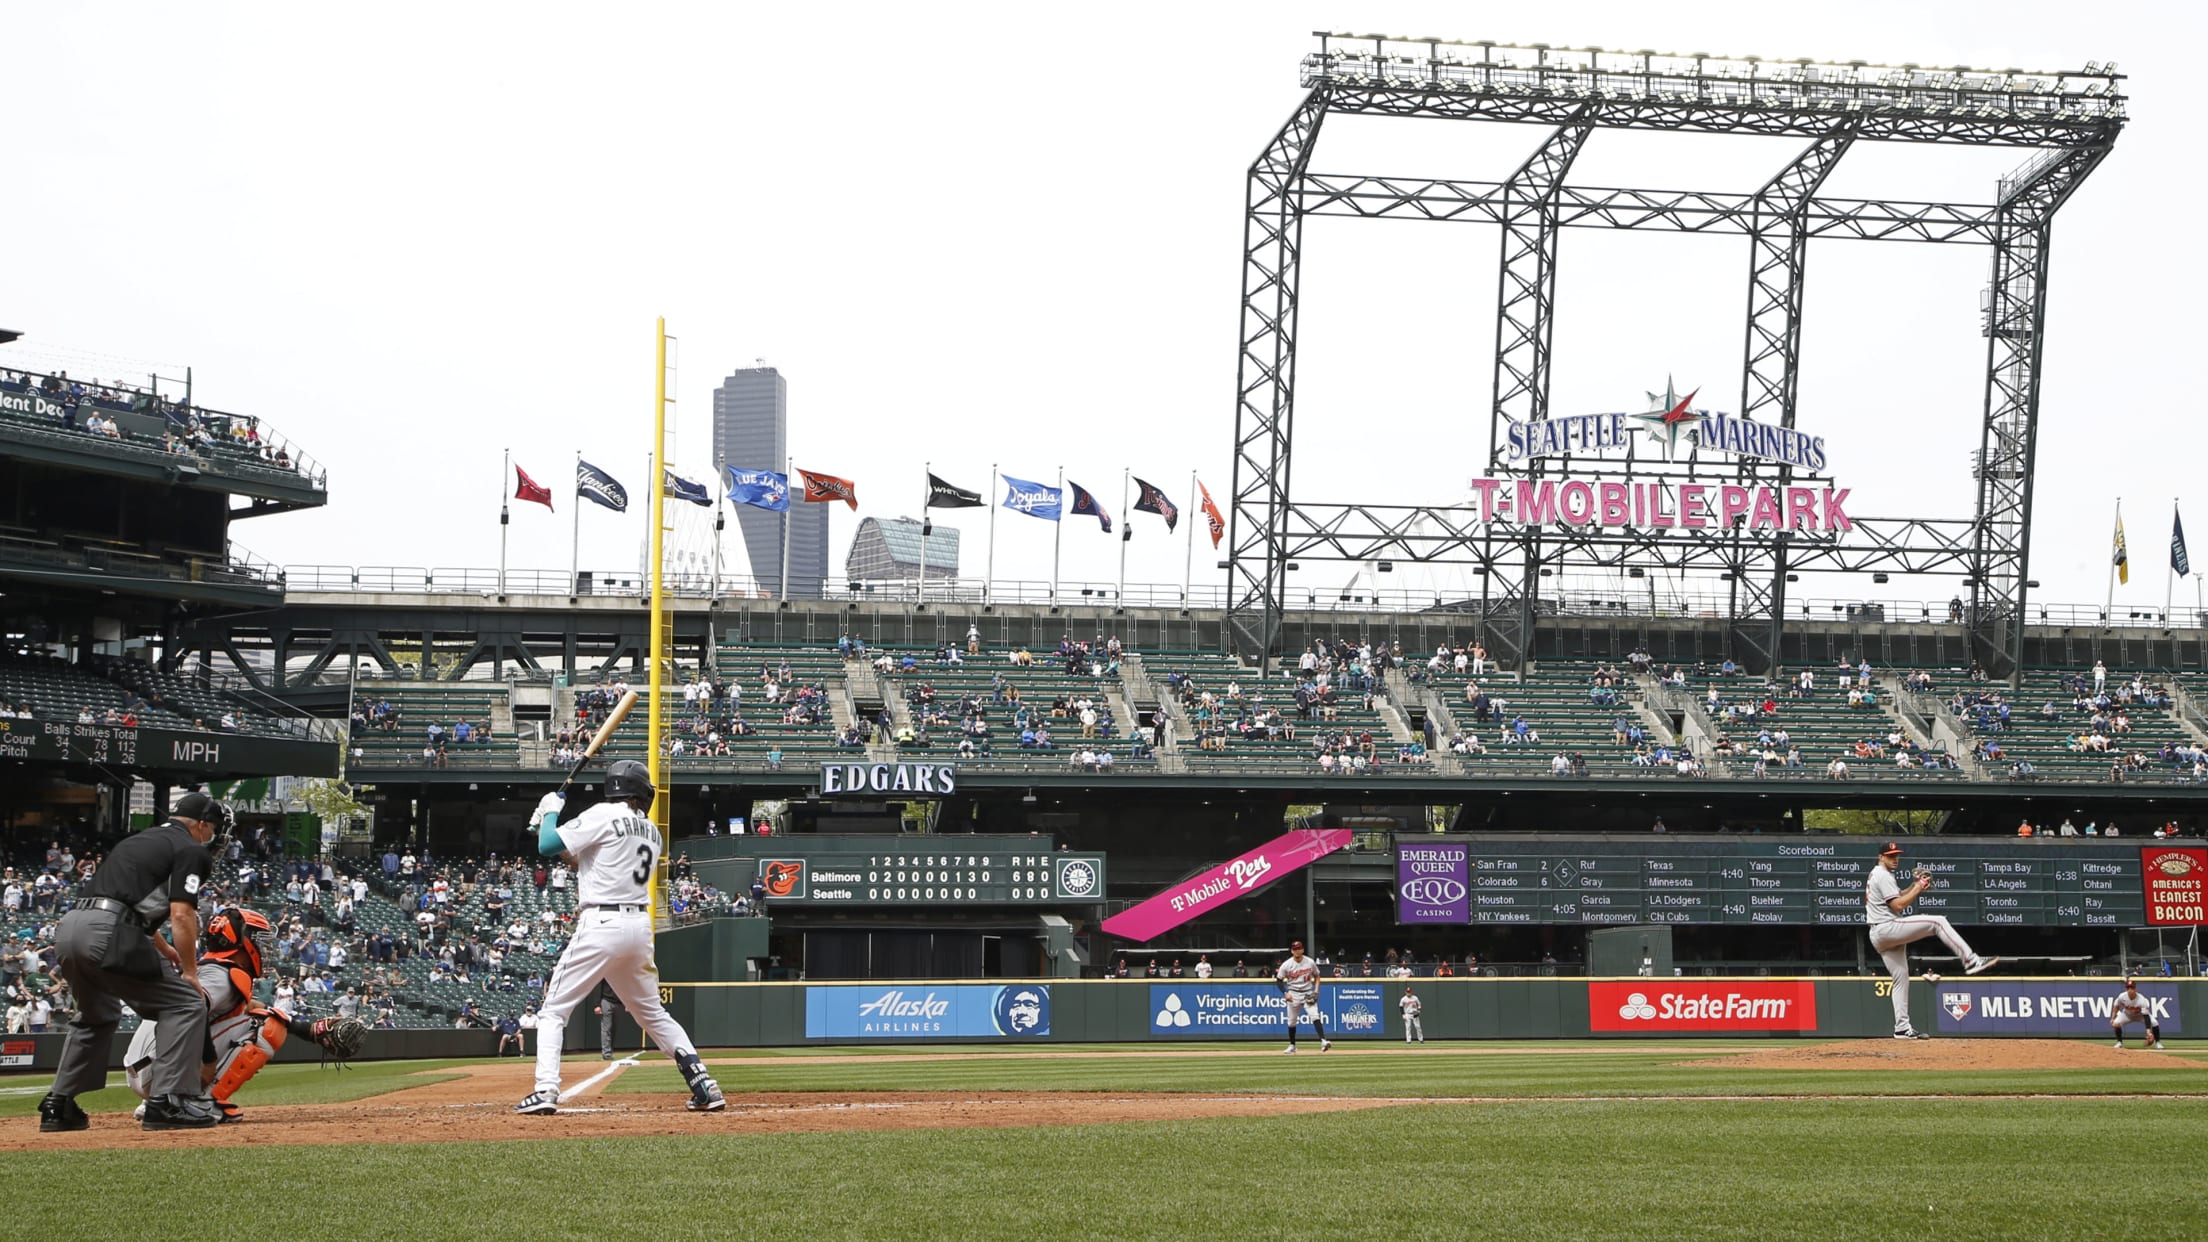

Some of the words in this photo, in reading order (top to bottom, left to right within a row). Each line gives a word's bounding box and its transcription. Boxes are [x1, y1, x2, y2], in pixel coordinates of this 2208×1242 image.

[1507, 413, 1628, 461] SEATTLE
[1698, 410, 1827, 471] MARINERS
[1472, 478, 1708, 529] T-MOBILE
[1718, 485, 1854, 532] PARK
[45, 723, 71, 735] Balls
[74, 725, 110, 738] Strikes
[113, 728, 138, 740] Total
[3, 732, 36, 745] Count
[56, 736, 70, 748] 34
[95, 738, 108, 750] 78
[118, 740, 136, 752] 112
[0, 744, 28, 758] Pitch
[174, 740, 220, 763] MPH
[61, 749, 69, 760] 2
[94, 751, 108, 763] 24
[122, 752, 136, 764] 26
[823, 763, 955, 794] EDGAR'S
[612, 817, 662, 848] CRAWFO
[1401, 850, 1465, 861] EMERALD
[1778, 846, 1834, 856] Scoreboard
[633, 843, 653, 888] 3
[870, 856, 876, 866] 1
[884, 856, 891, 866] 2
[898, 856, 905, 866] 3
[912, 856, 919, 866] 4
[926, 856, 934, 866] 5
[940, 856, 948, 866] 6
[954, 856, 962, 866] 7
[968, 856, 976, 866] 8
[982, 856, 990, 866] 9
[1012, 856, 1020, 866] R
[1026, 856, 1034, 866] H
[1040, 856, 1049, 866] E
[1478, 860, 1494, 870] San
[1498, 860, 1518, 870] Fran
[1541, 861, 1548, 870] 2
[1580, 860, 1596, 870] Ruf
[1648, 860, 1674, 870] Texas
[1411, 862, 1455, 874] QUEEN
[1750, 862, 1772, 872] Yang
[1816, 862, 1860, 872] Pittsburgh
[1983, 863, 2012, 874] Tampa
[2015, 863, 2032, 874] Bay
[2083, 864, 2122, 874] Kittredge
[812, 872, 862, 882] Baltimore
[869, 871, 877, 882] 0
[883, 871, 891, 882] 2
[898, 871, 906, 882] 0
[912, 871, 920, 882] 0
[926, 871, 934, 882] 0
[940, 871, 948, 882] 0
[955, 871, 960, 882] 1
[968, 871, 976, 882] 3
[982, 871, 990, 882] 0
[1012, 871, 1020, 882] 6
[1026, 871, 1034, 882] 8
[1041, 871, 1049, 882] 0
[1561, 868, 1568, 878] 5
[1721, 868, 1744, 878] 4:40
[2056, 871, 2078, 881] 6:38
[1478, 877, 1518, 886] Colorado
[1541, 878, 1548, 886] 6
[1580, 878, 1602, 888] Gray
[1649, 878, 1693, 887] Minnesota
[1750, 878, 1780, 889] Thorpe
[1818, 878, 1834, 888] San
[1836, 878, 1862, 889] Diego
[1984, 880, 1997, 888] LA
[1998, 880, 2027, 890] Angels
[2084, 880, 2112, 889] Ohtani
[2152, 880, 2201, 889] AMERICA'S
[813, 889, 852, 899] Seattle
[869, 888, 877, 900] 0
[883, 888, 891, 900] 0
[898, 888, 906, 900] 0
[912, 888, 920, 900] 0
[926, 888, 934, 900] 0
[940, 888, 948, 900] 0
[954, 888, 962, 900] 0
[968, 888, 976, 900] 0
[1012, 888, 1020, 899] 0
[1026, 888, 1034, 899] 0
[1040, 888, 1049, 899] 0
[1184, 877, 1231, 907] Mobile
[1410, 880, 1460, 905] EQC
[2153, 891, 2202, 902] LEANEST
[1478, 896, 1514, 904] Houston
[1581, 895, 1610, 904] Garcia
[1650, 896, 1662, 904] LA
[1664, 896, 1702, 906] Dodgers
[1752, 896, 1784, 905] Buehler
[1818, 896, 1860, 905] Cleveland
[1919, 896, 1946, 906] Bieber
[1985, 897, 2018, 906] Toronto
[2085, 898, 2102, 908] Ray
[1552, 904, 1576, 914] 4:05
[1722, 904, 1745, 914] 4:40
[2058, 906, 2080, 916] 6:40
[2154, 906, 2204, 920] BACON
[1478, 912, 1492, 920] NY
[1494, 912, 1530, 920] Yankees
[1582, 912, 1637, 922] Montgomery
[1650, 912, 1664, 921] Chi
[1666, 912, 1690, 921] Cubs
[1752, 912, 1783, 923] Alzolay
[1819, 912, 1852, 922] Kansas
[1854, 912, 1866, 922] Cit
[1986, 914, 2022, 923] Oakland
[2086, 914, 2116, 924] Bassitt
[1874, 982, 1893, 997] 37
[858, 990, 949, 1019] Alaska
[1196, 994, 1252, 1012] Virginia
[1256, 995, 1288, 1008] Mas
[1659, 993, 1724, 1019] State
[1726, 994, 1785, 1019] Farm
[1981, 996, 2033, 1018] MLB
[2041, 996, 2170, 1018] NETWK
[1197, 1010, 1276, 1025] Franciscan
[1280, 1010, 1329, 1025] Heah
[1341, 1013, 1377, 1024] MARINERS
[864, 1022, 941, 1032] AIRLINES
